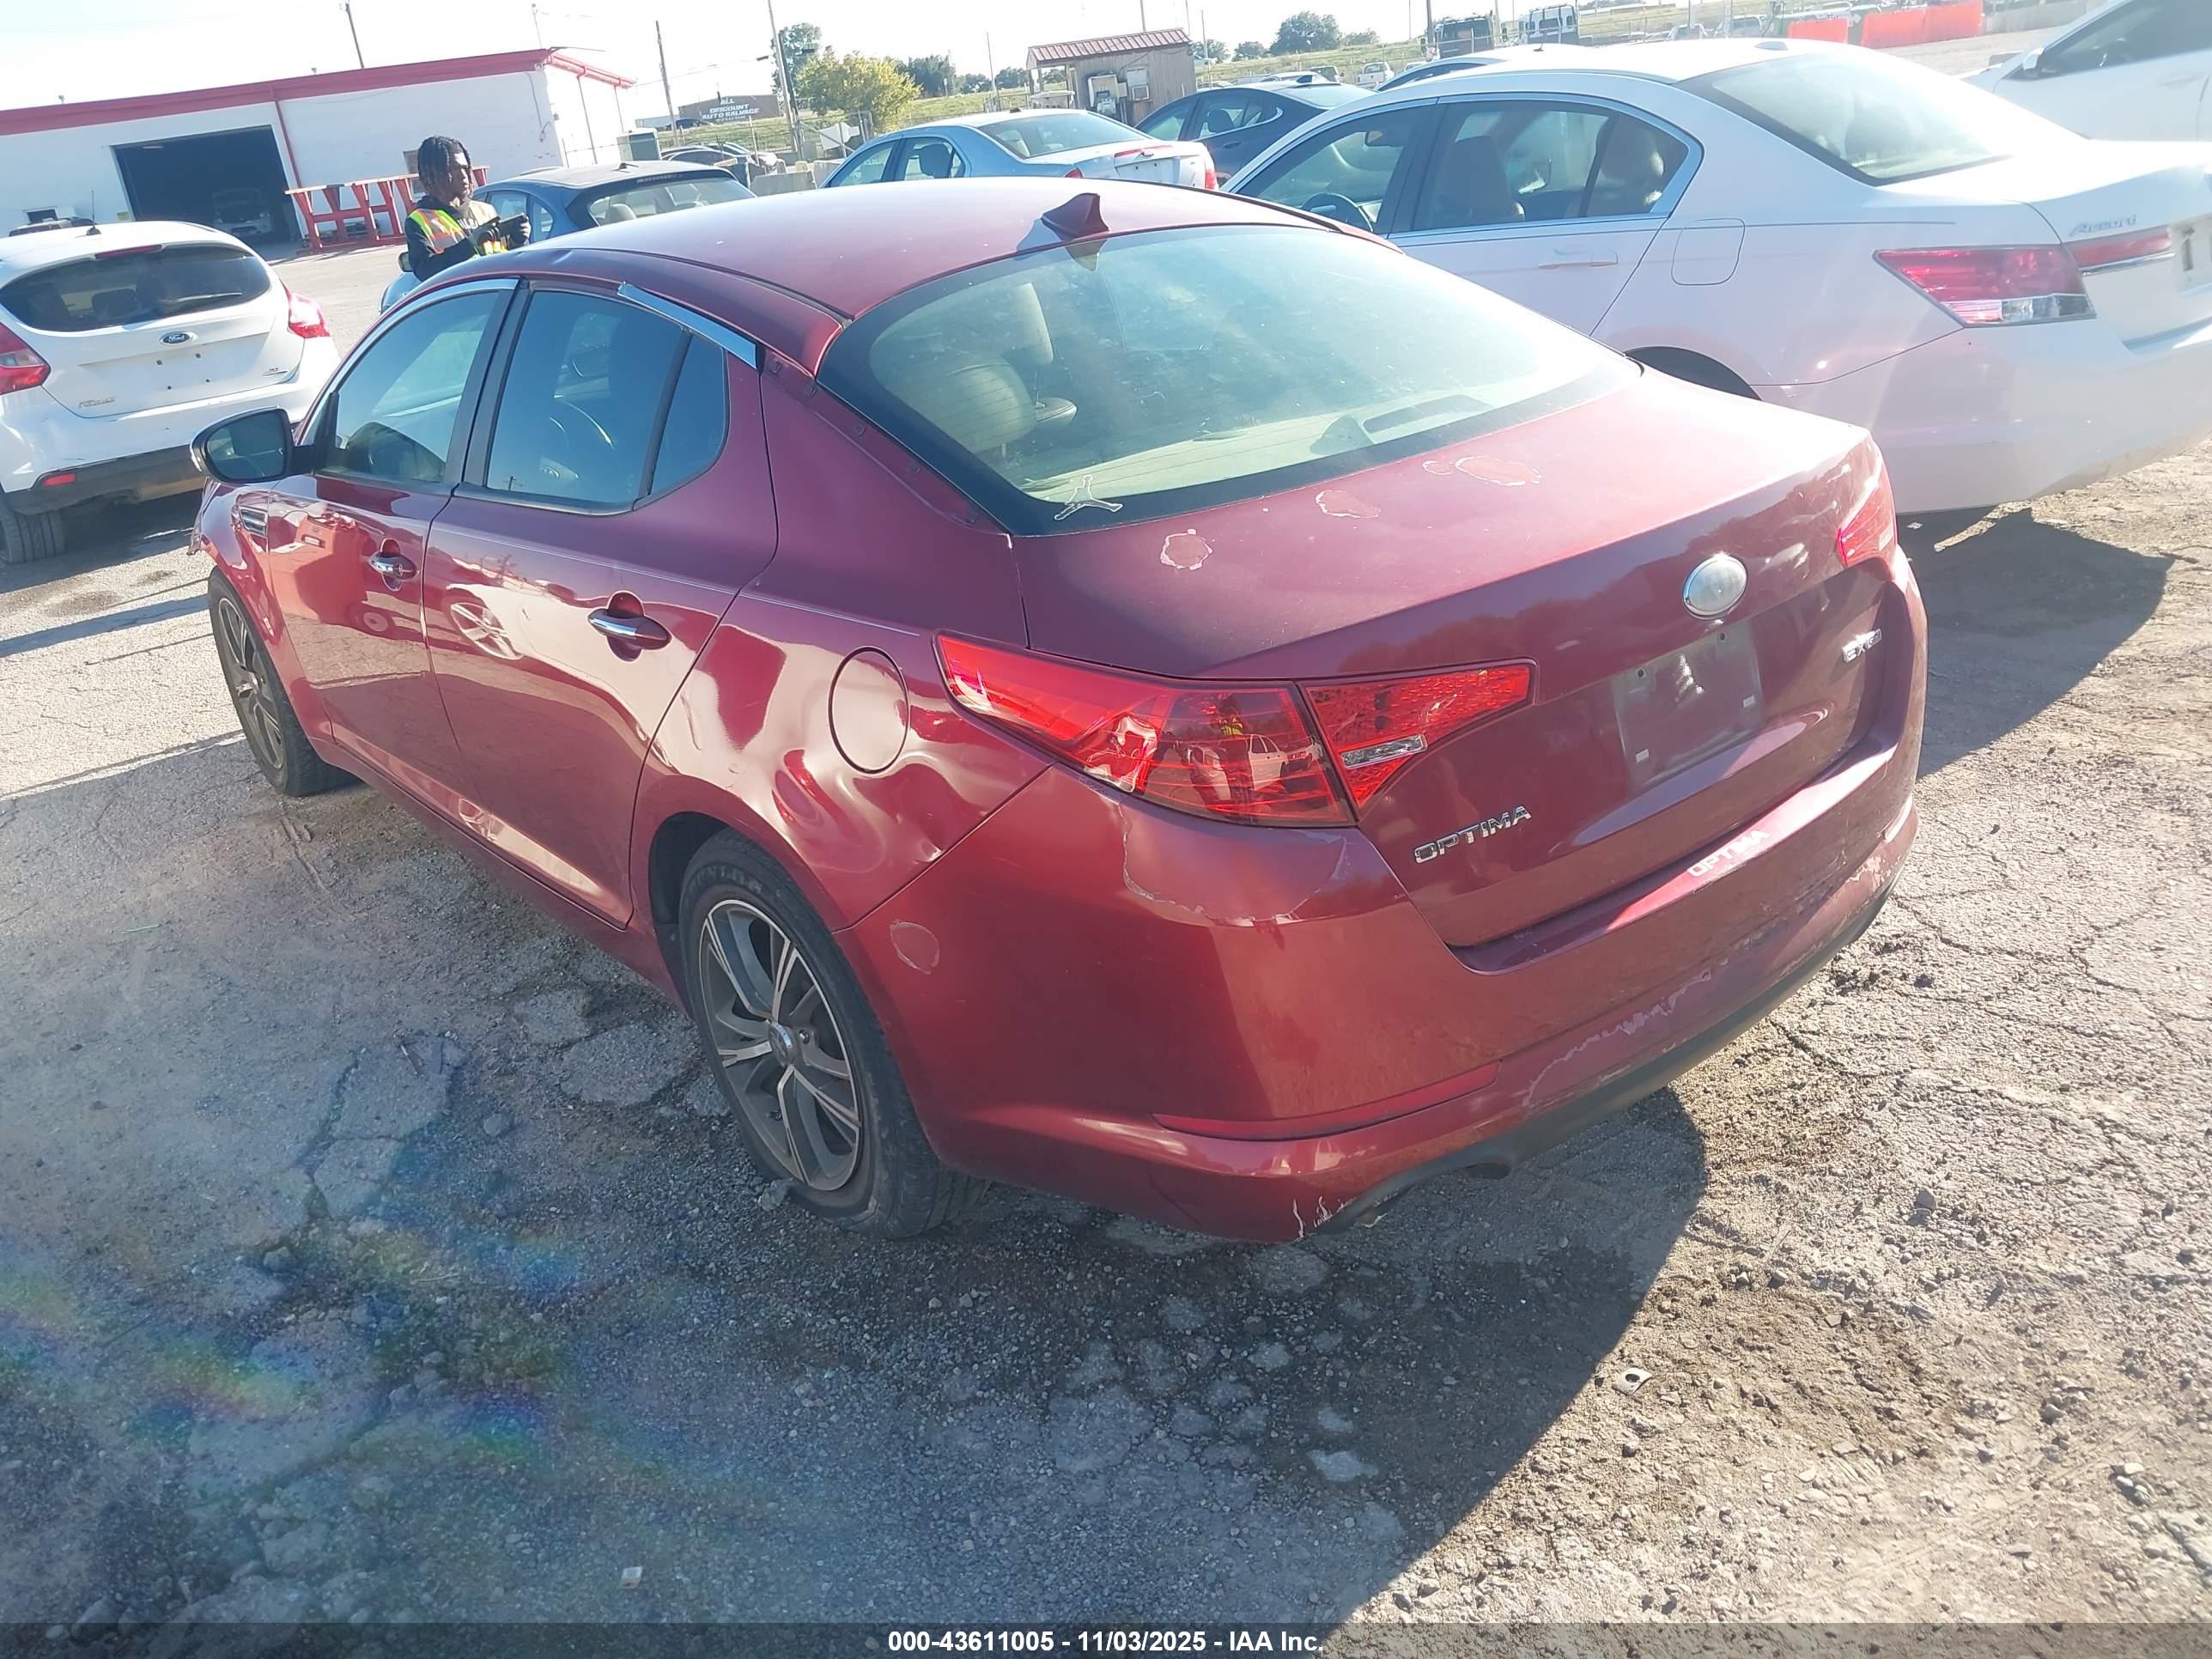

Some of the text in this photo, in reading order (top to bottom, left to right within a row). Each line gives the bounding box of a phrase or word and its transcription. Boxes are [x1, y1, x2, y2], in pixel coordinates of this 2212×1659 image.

[702, 112, 725, 120] AUTO
[725, 107, 760, 118] SALVAGE
[709, 103, 750, 113] DISCOUNT
[1841, 634, 1868, 663] EX
[1413, 804, 1533, 864] OPTIMA
